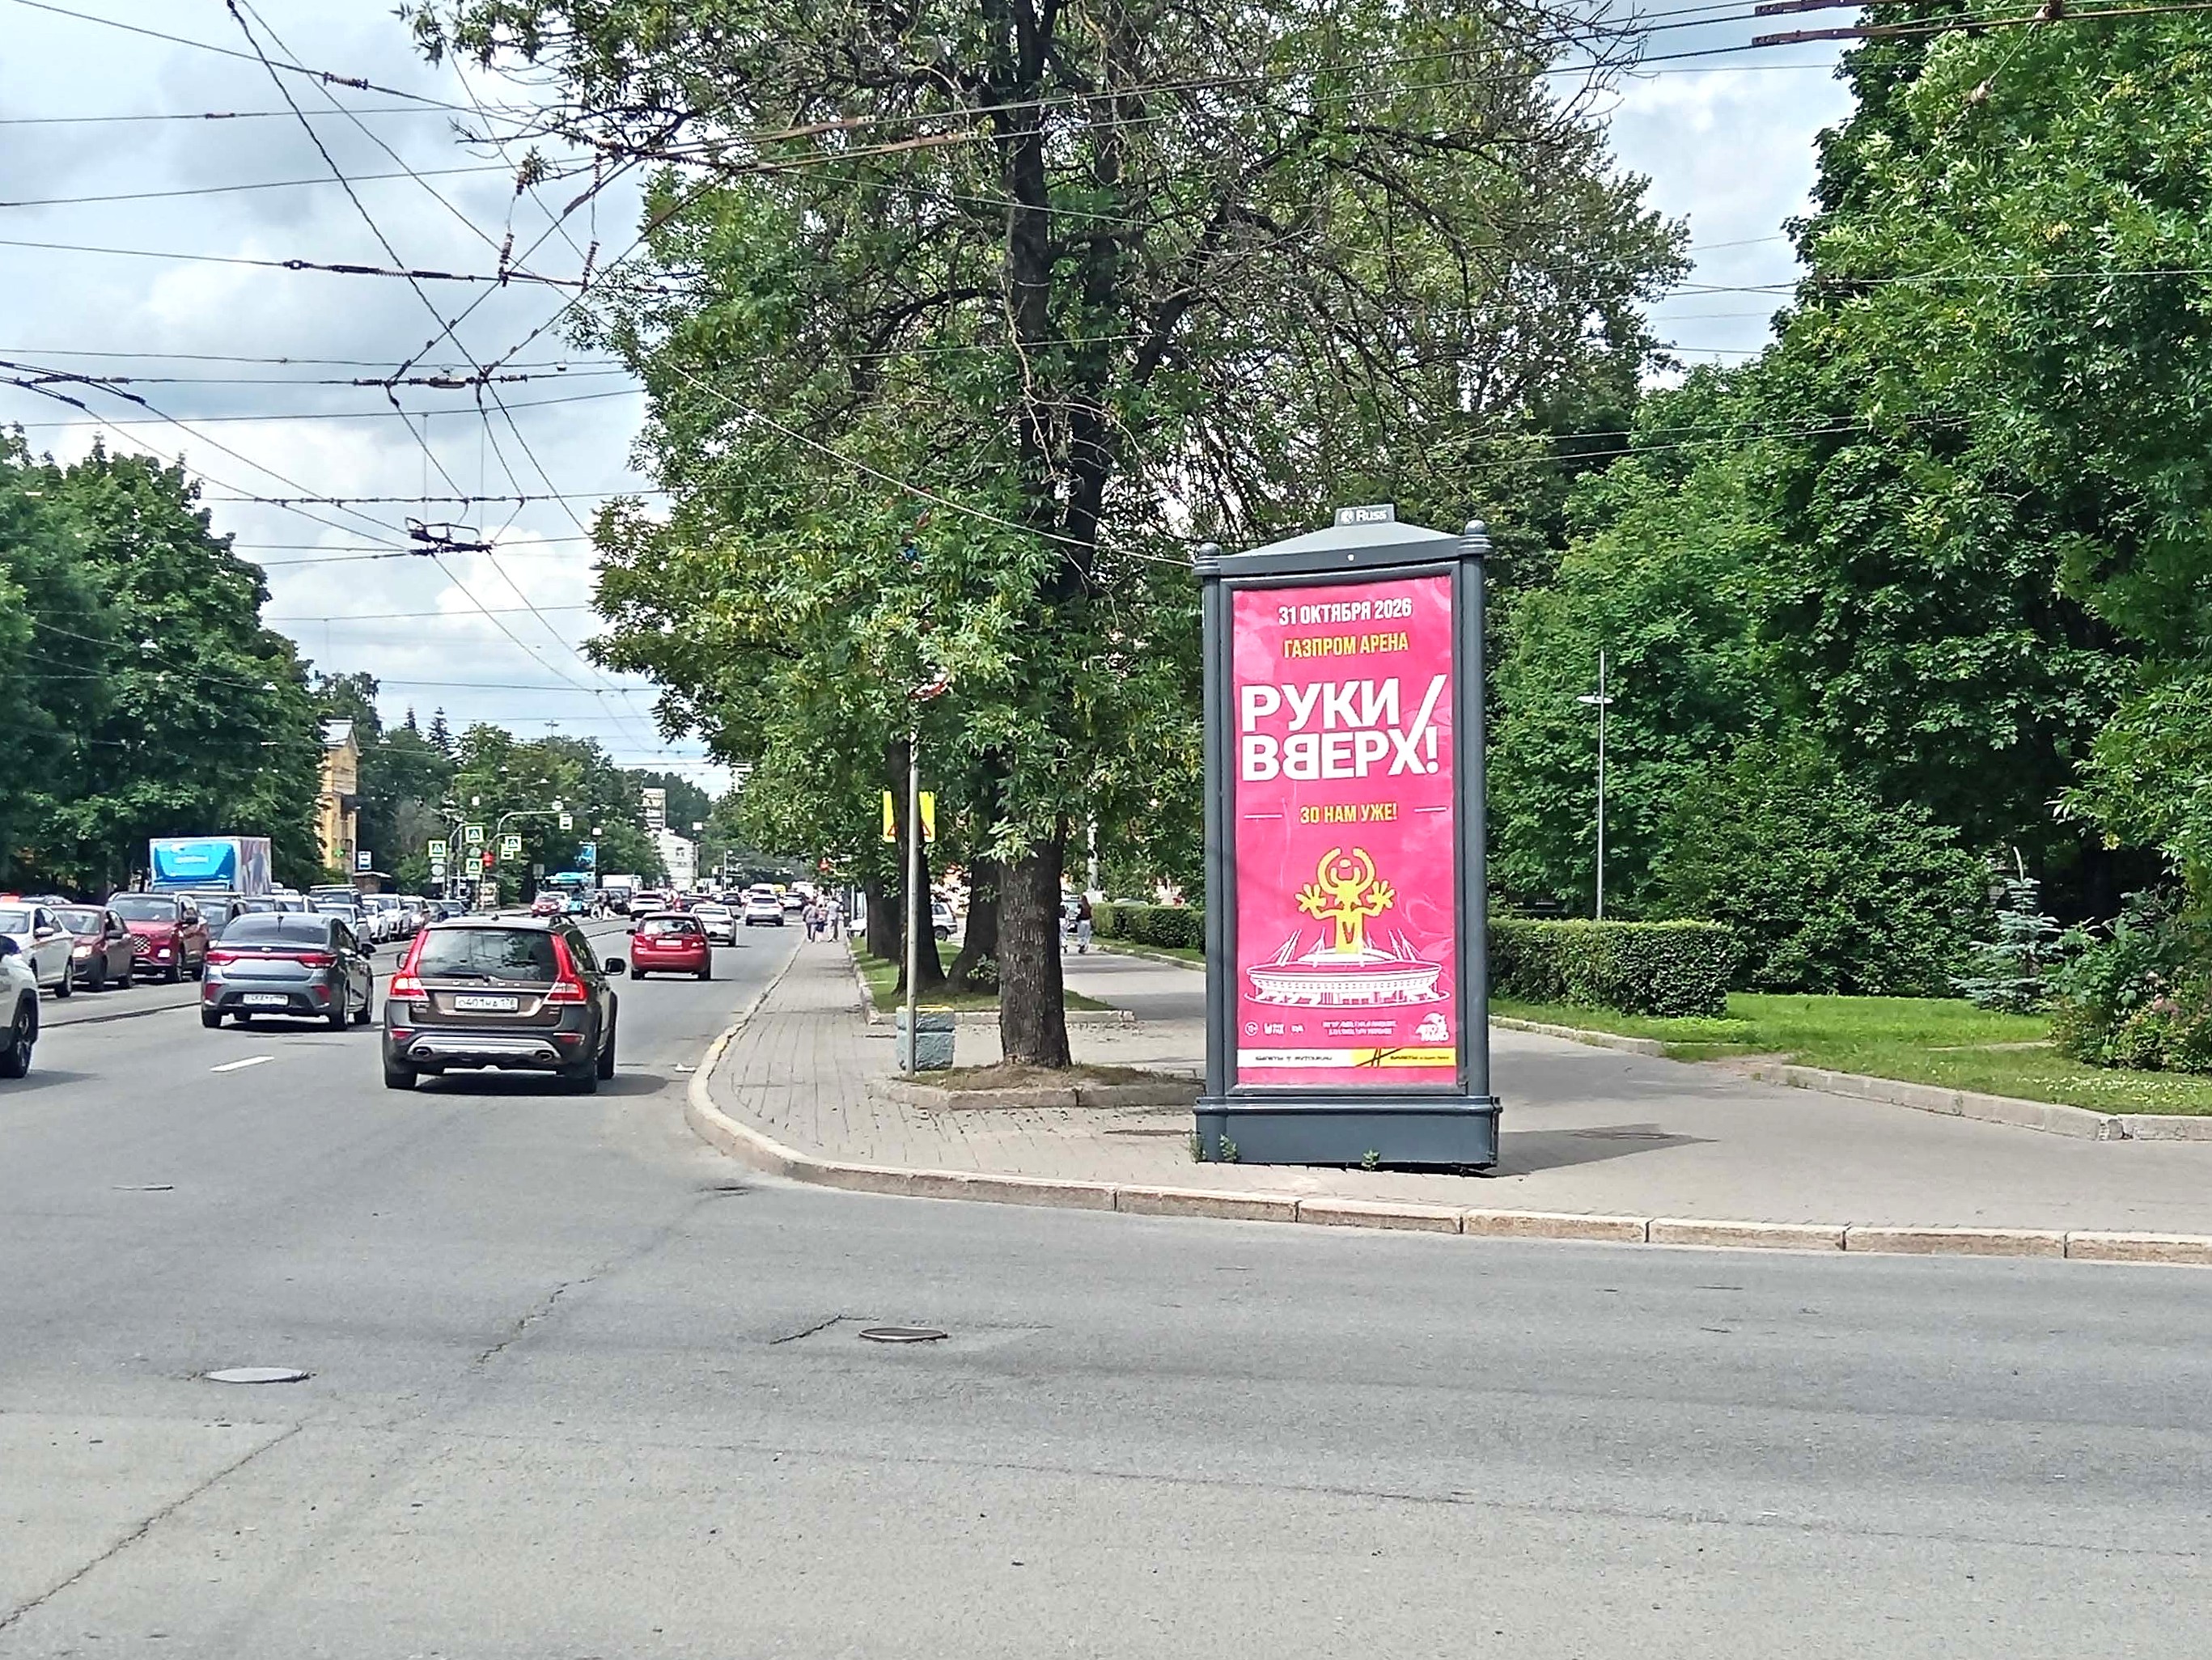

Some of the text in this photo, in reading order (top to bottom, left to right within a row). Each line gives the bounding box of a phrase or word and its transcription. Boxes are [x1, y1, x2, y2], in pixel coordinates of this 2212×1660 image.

[1356, 509, 1387, 522] Russ
[1278, 597, 1412, 625] 31 ОКТЯБРЯ 2026
[1284, 632, 1409, 658] ГАЗПРОМ АРЕНА
[1240, 677, 1400, 732] РУКИ
[1300, 802, 1398, 824] 30 НАМ УЖЕ!
